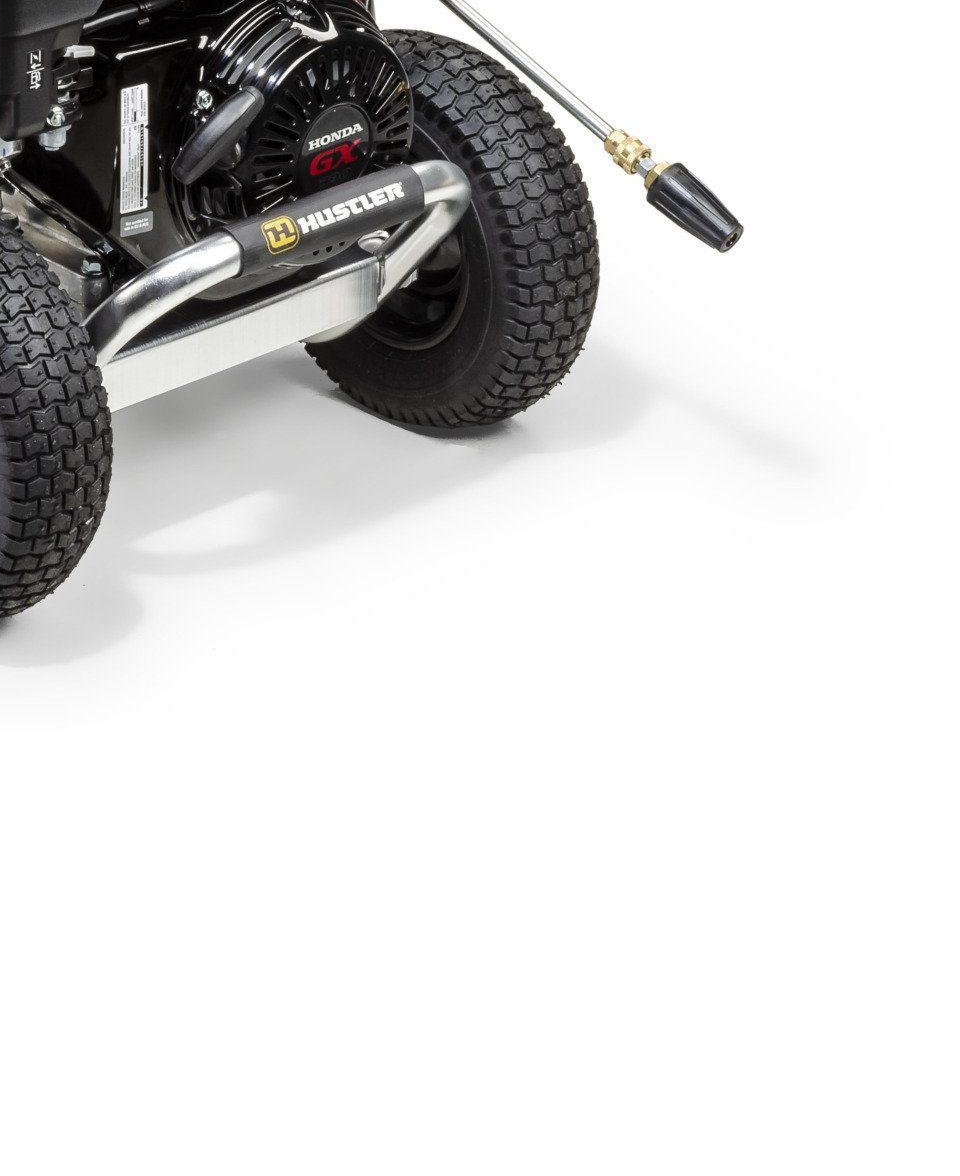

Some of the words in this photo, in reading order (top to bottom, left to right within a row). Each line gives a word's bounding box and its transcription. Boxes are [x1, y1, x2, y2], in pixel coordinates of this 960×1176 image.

[308, 123, 364, 151] HONDA
[309, 138, 362, 176] GX
[297, 182, 406, 235] HUSTLER
